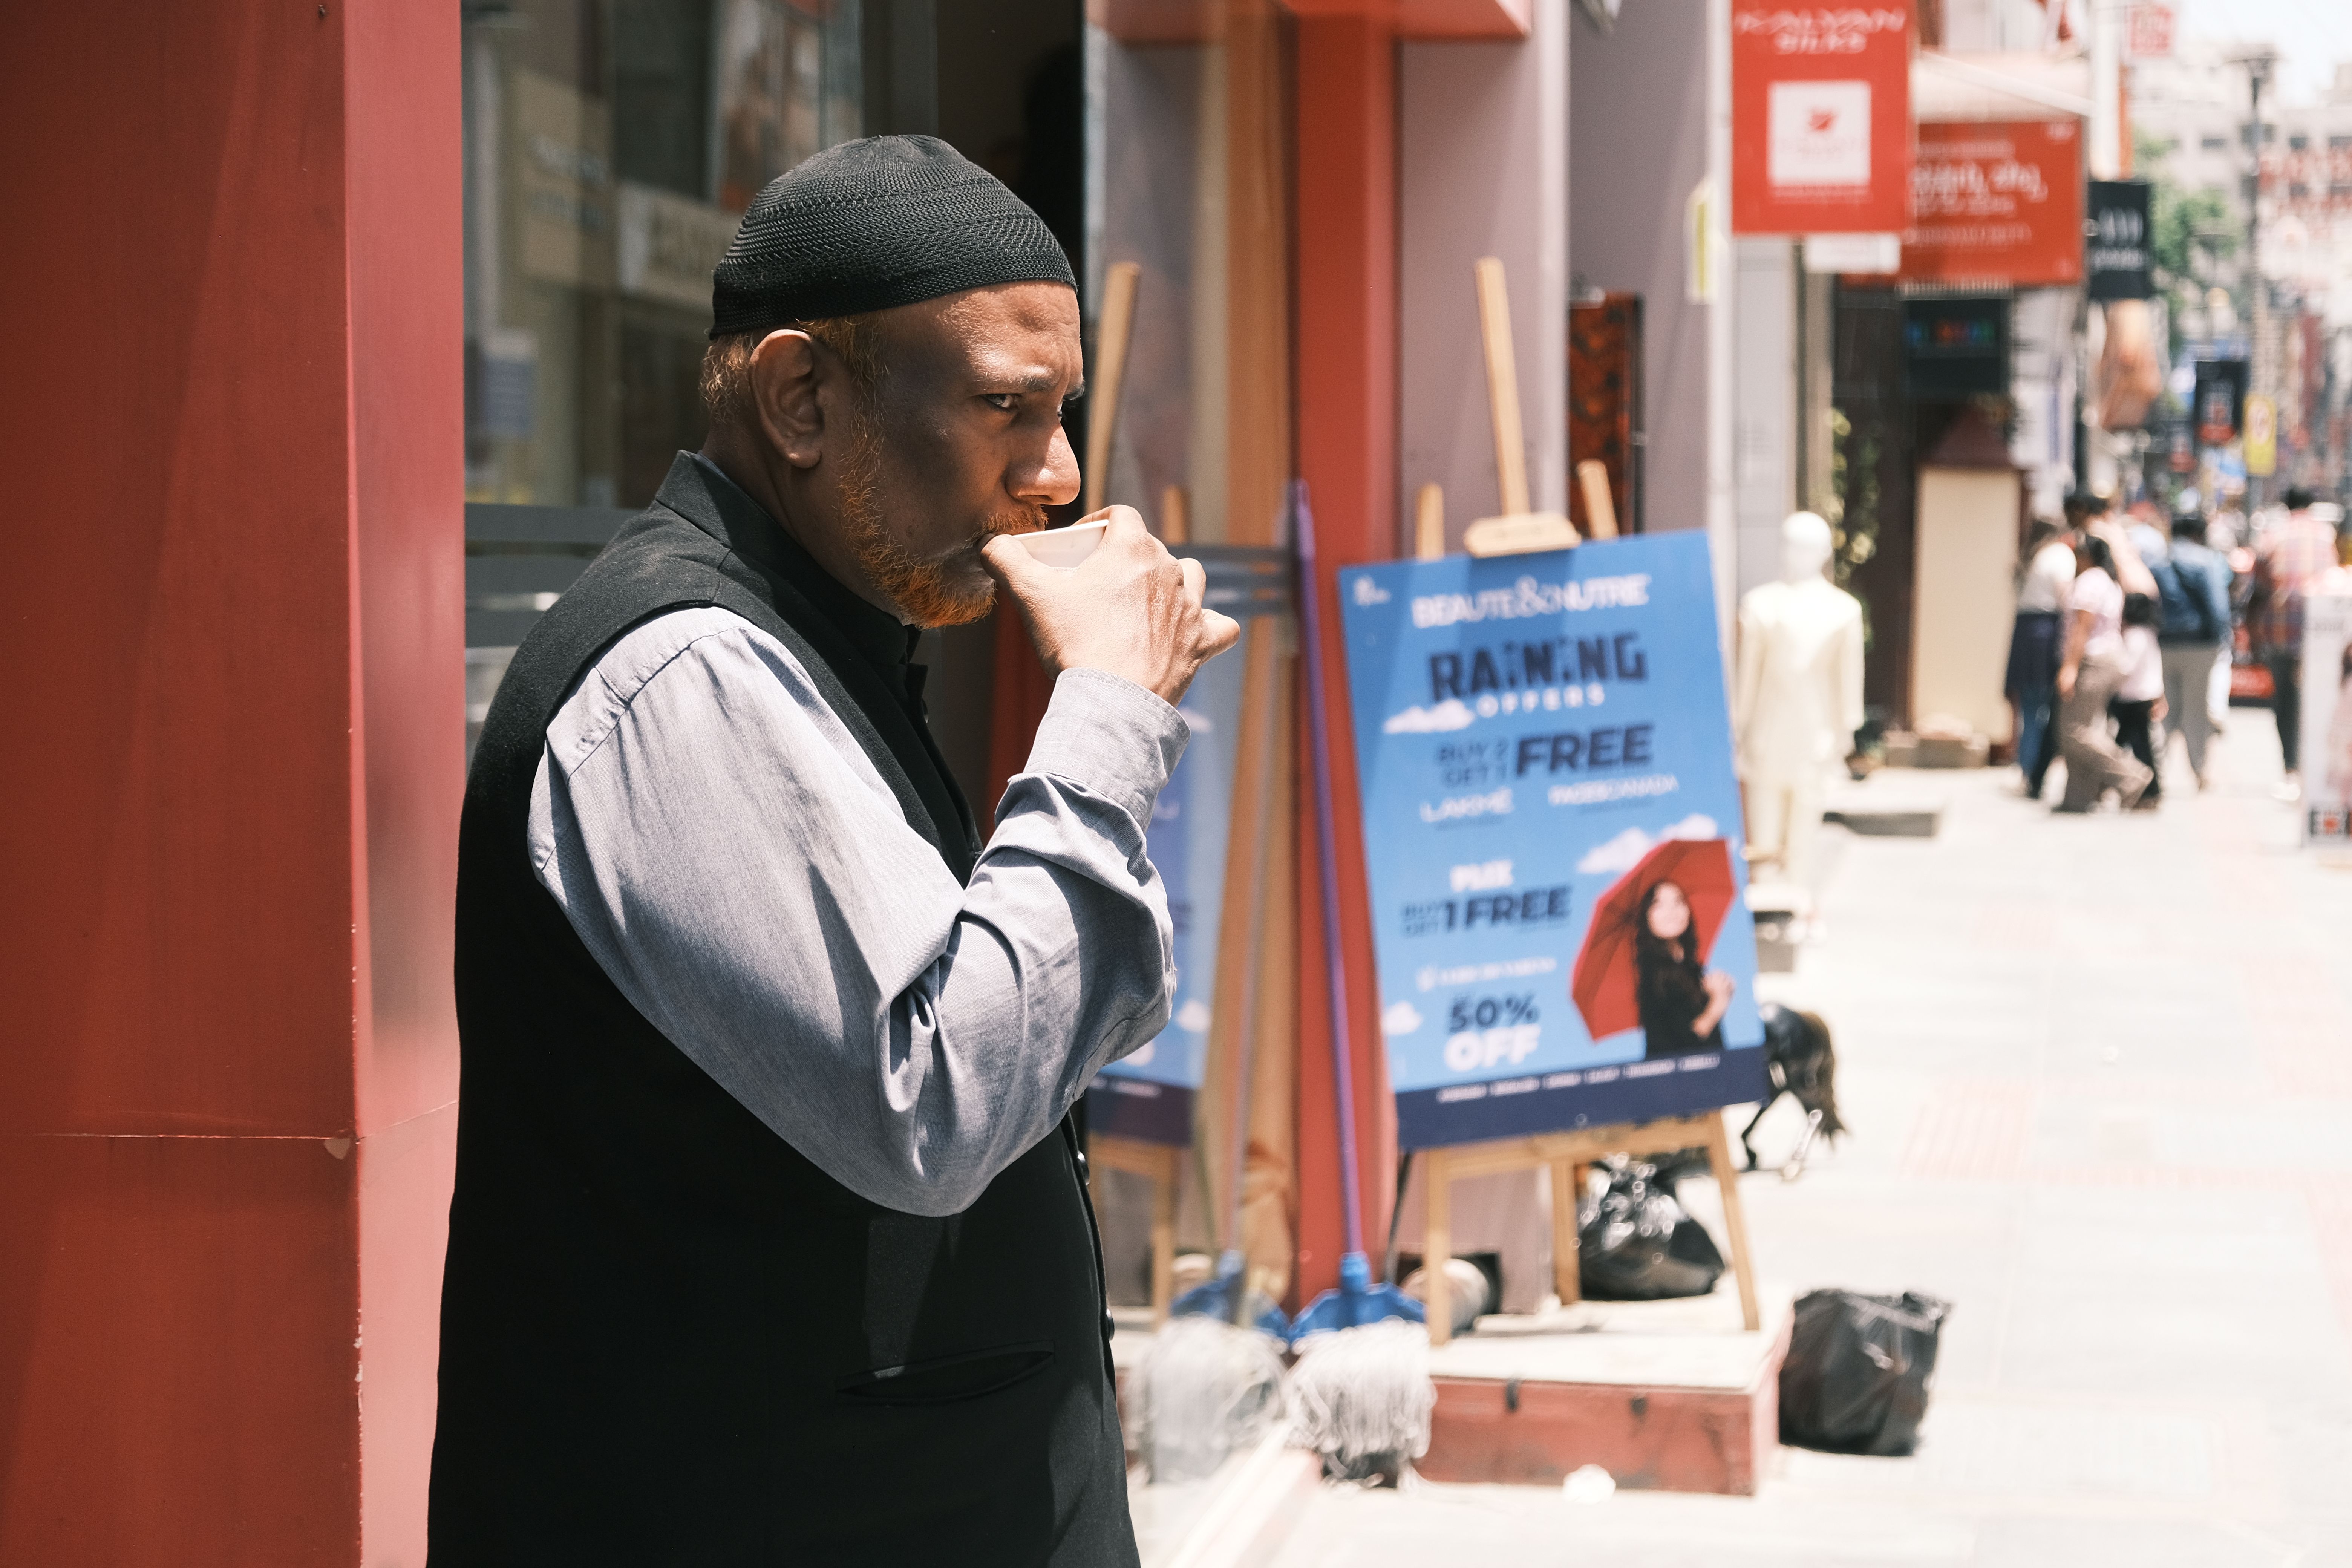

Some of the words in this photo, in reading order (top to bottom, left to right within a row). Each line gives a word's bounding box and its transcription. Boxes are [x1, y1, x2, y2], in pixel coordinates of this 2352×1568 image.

[1429, 631, 1648, 701] RAINING
[1476, 683, 1604, 717] OFFERS
[1438, 740, 1491, 765] BUY
[1517, 724, 1653, 775] FREE
[1443, 765, 1489, 788] GET
[1464, 886, 1570, 926] FREE
[1449, 992, 1539, 1032] 50%
[1445, 1026, 1539, 1071] OFF
